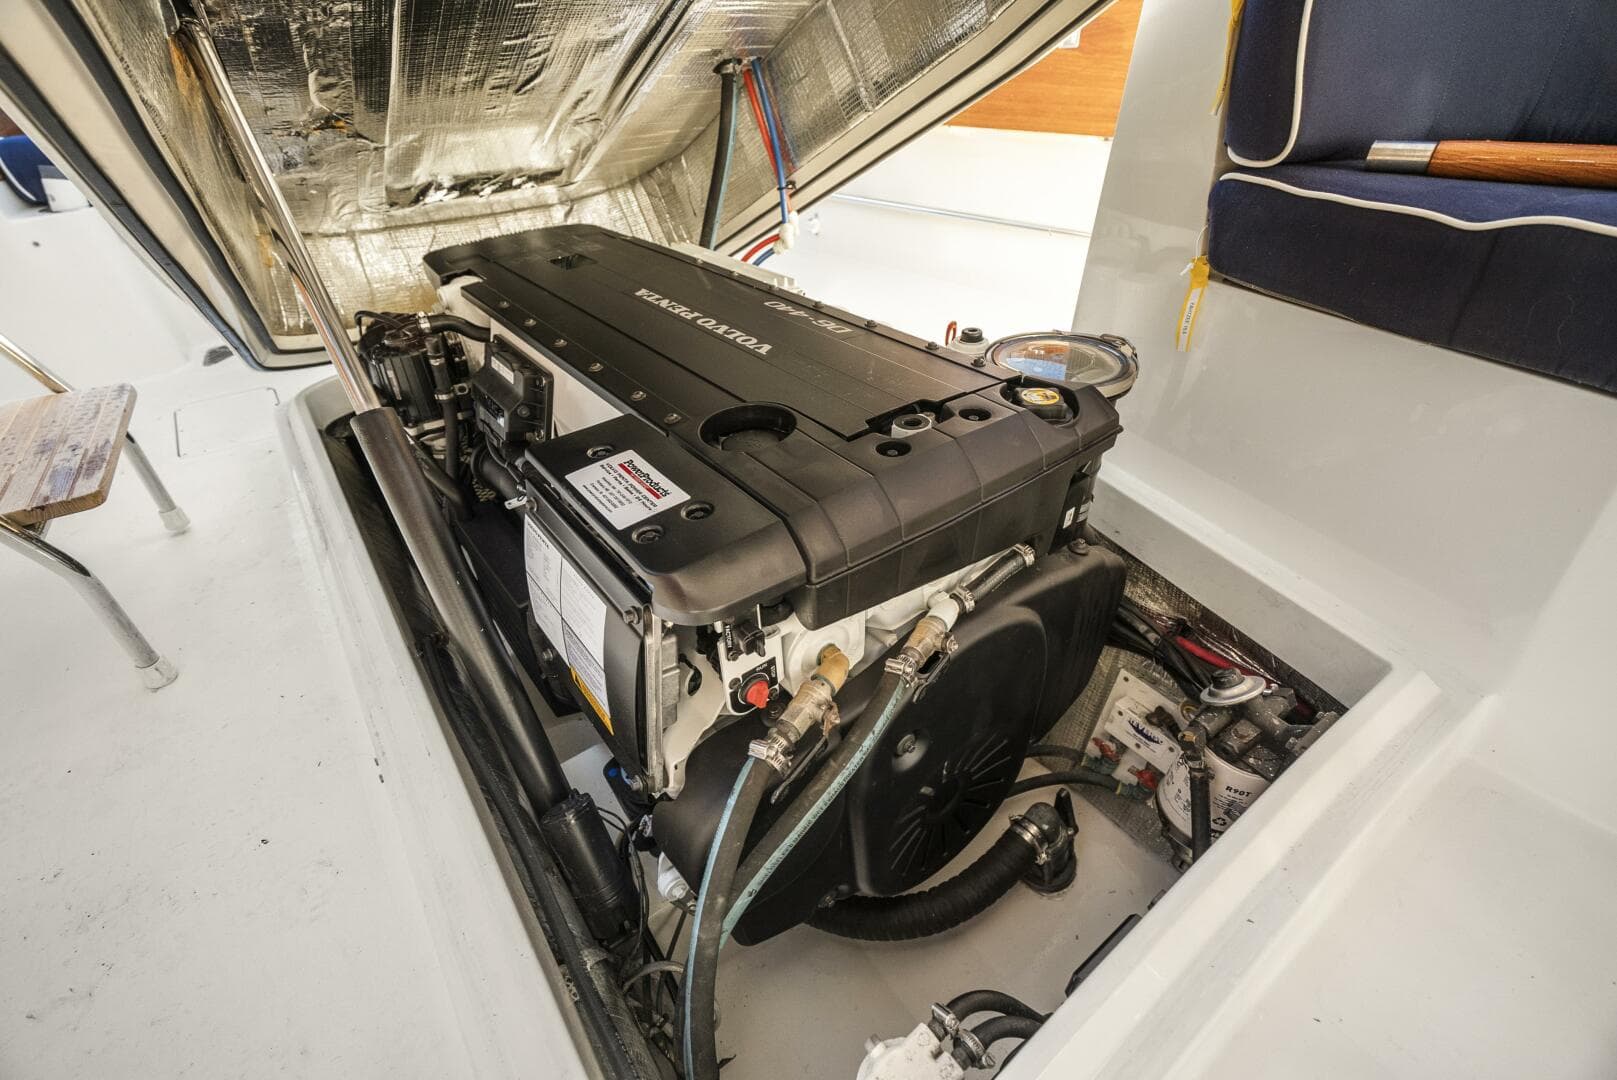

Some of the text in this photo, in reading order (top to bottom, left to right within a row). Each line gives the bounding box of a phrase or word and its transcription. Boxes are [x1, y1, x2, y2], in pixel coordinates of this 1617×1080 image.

[634, 288, 774, 355] VOLVO PENTA
[764, 300, 854, 334] D6-440
[623, 459, 671, 497] PowerProducts
